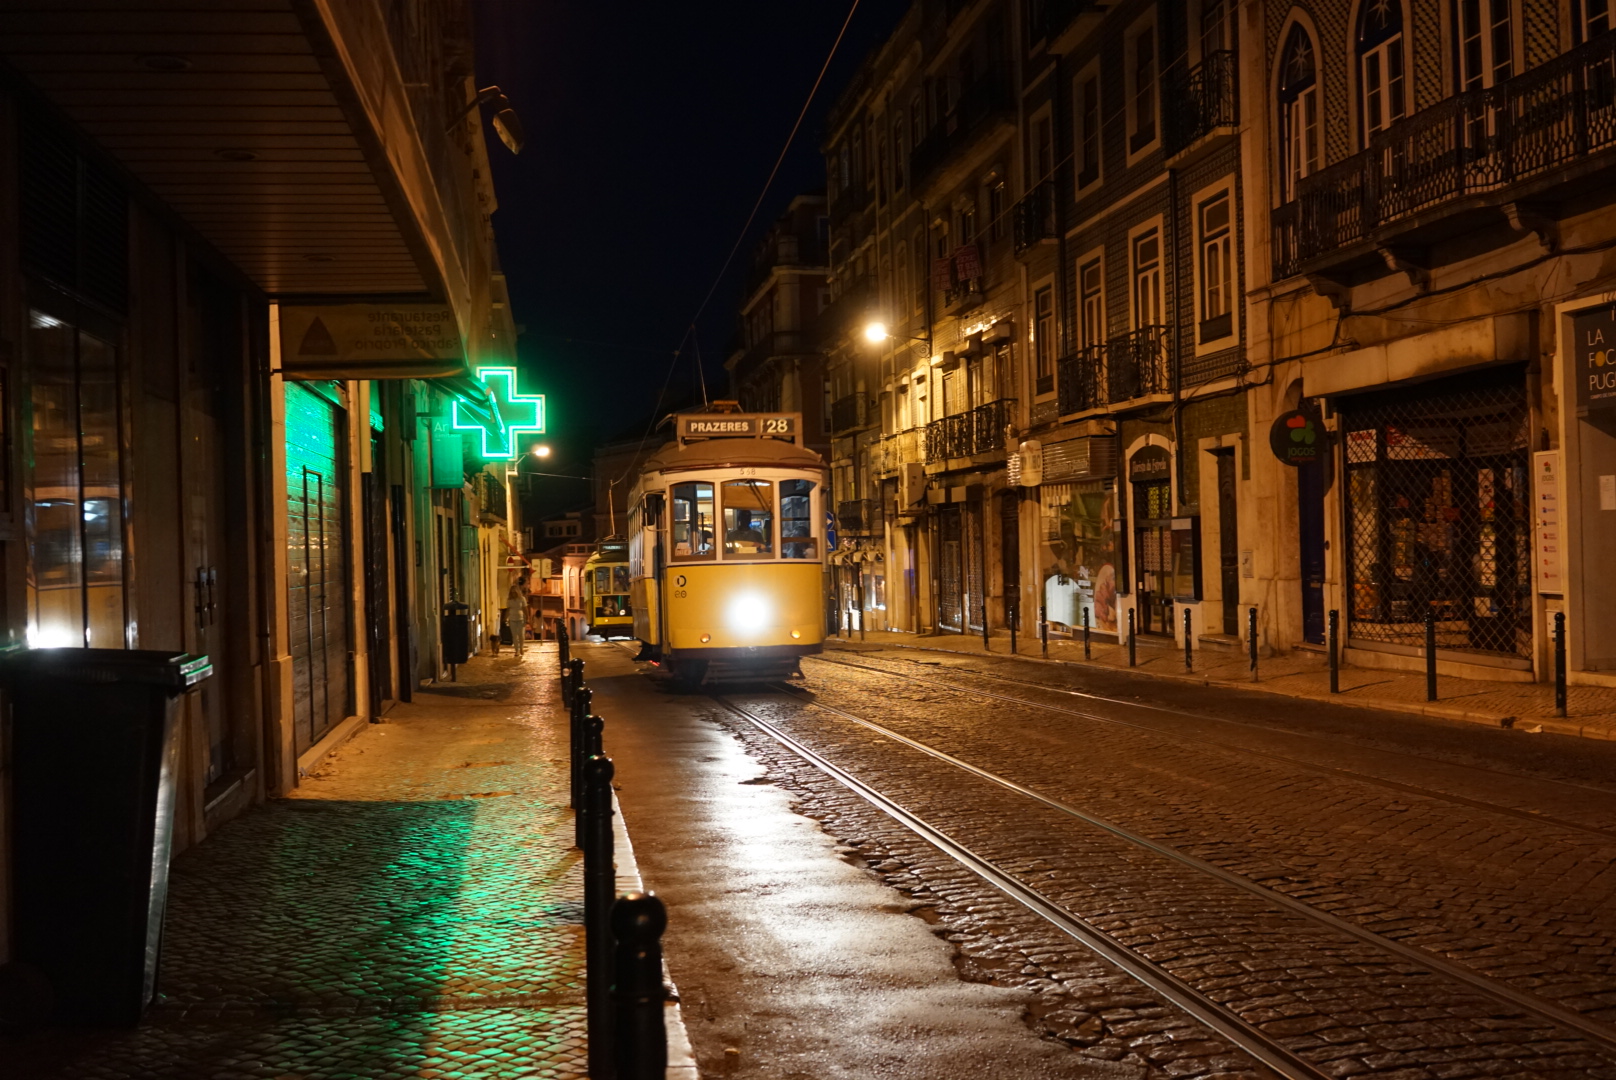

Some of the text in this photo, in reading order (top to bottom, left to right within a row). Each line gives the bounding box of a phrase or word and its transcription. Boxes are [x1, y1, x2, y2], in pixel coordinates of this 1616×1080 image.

[1587, 328, 1605, 346] LA
[1588, 348, 1616, 369] FOC
[690, 418, 789, 434] PRAZERES 28
[1288, 447, 1316, 459] JOGOS
